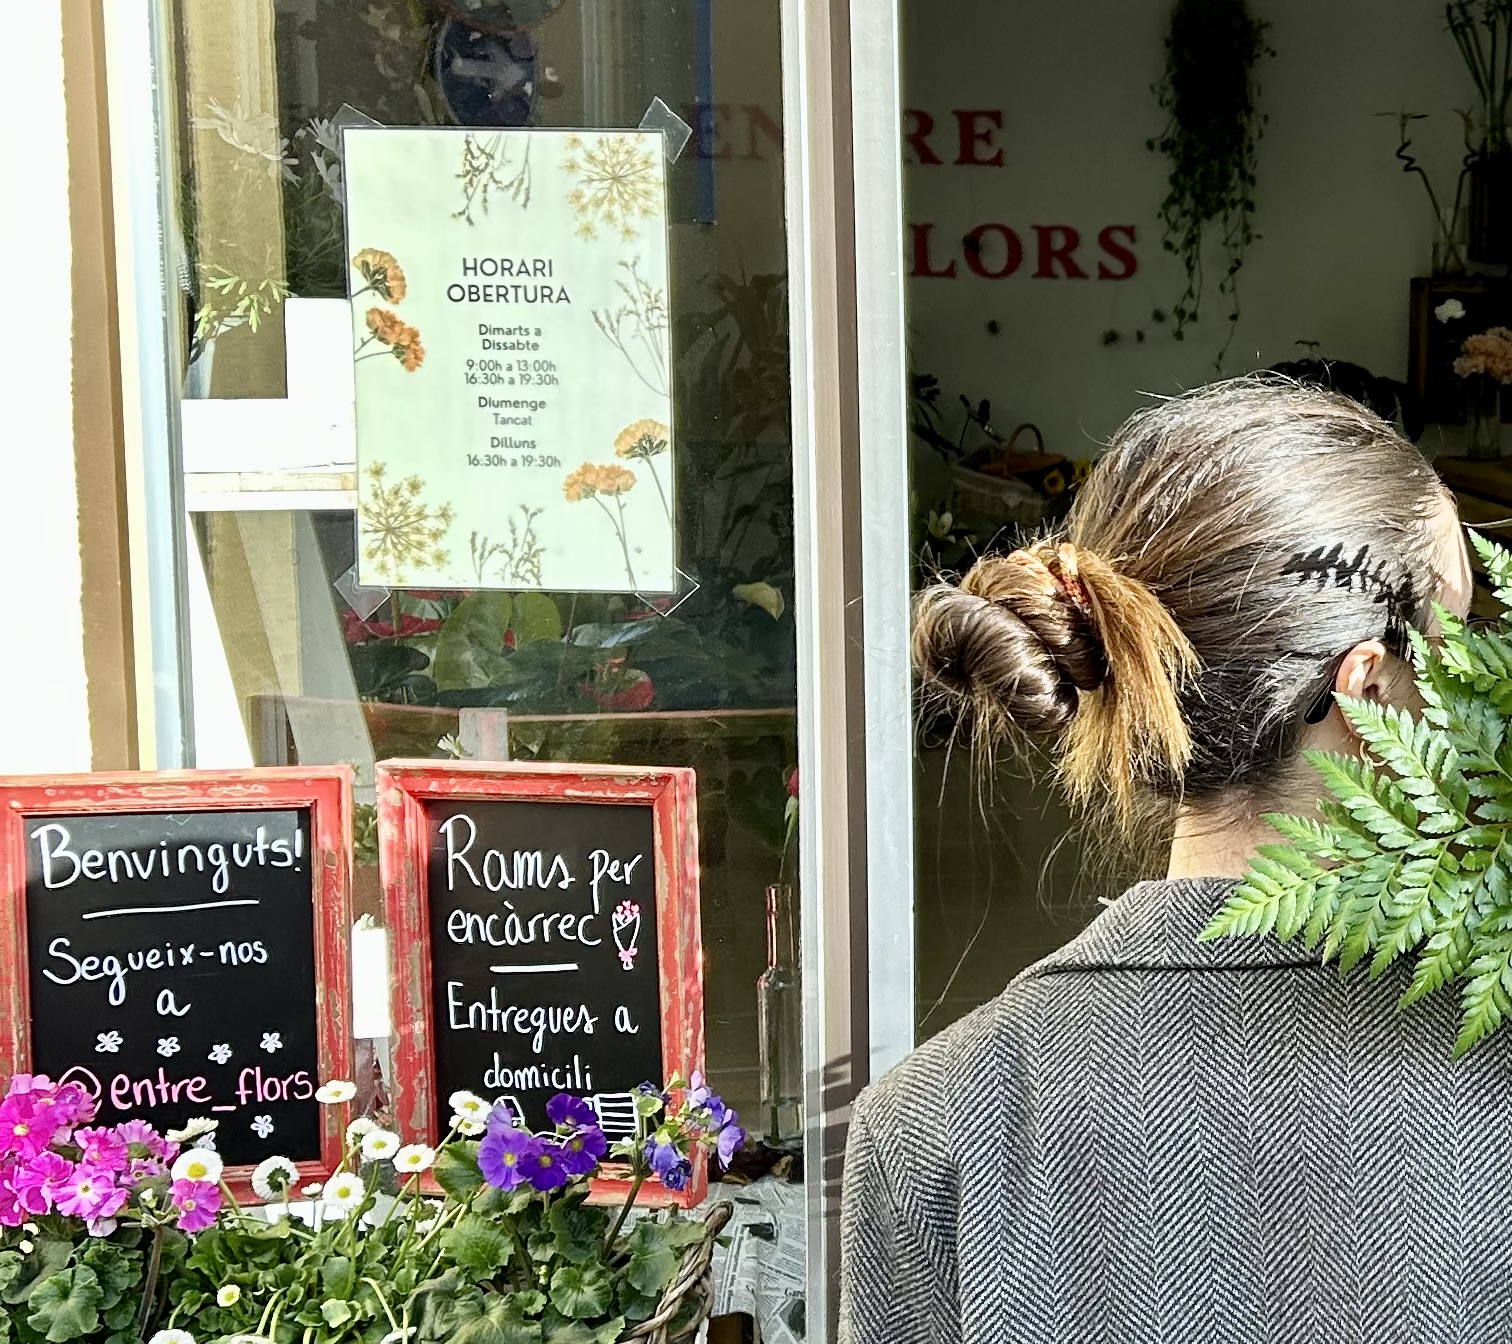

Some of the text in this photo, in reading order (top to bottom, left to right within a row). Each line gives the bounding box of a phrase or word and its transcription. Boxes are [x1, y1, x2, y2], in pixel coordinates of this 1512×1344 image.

[462, 258, 553, 277] HORARI
[447, 284, 571, 304] OBERTURA
[478, 324, 542, 337] Dimarts a
[482, 339, 540, 351] Dissabte
[466, 359, 557, 372] 9:00h a 13:00h
[464, 372, 559, 386] 16:30h a 19:30h
[478, 396, 547, 412] Diumenge
[493, 413, 533, 426] Tancat
[490, 436, 537, 449] Dilluns
[467, 454, 561, 468] 16:30h a 19:30h
[31, 823, 303, 894] Benvinguts!
[439, 814, 643, 914] Rams per
[447, 901, 602, 947] encàrrec
[43, 937, 268, 1006] Segueix-nos
[157, 988, 191, 1017] a
[448, 982, 639, 1054] Entregues a
[484, 1052, 592, 1091] domicili
